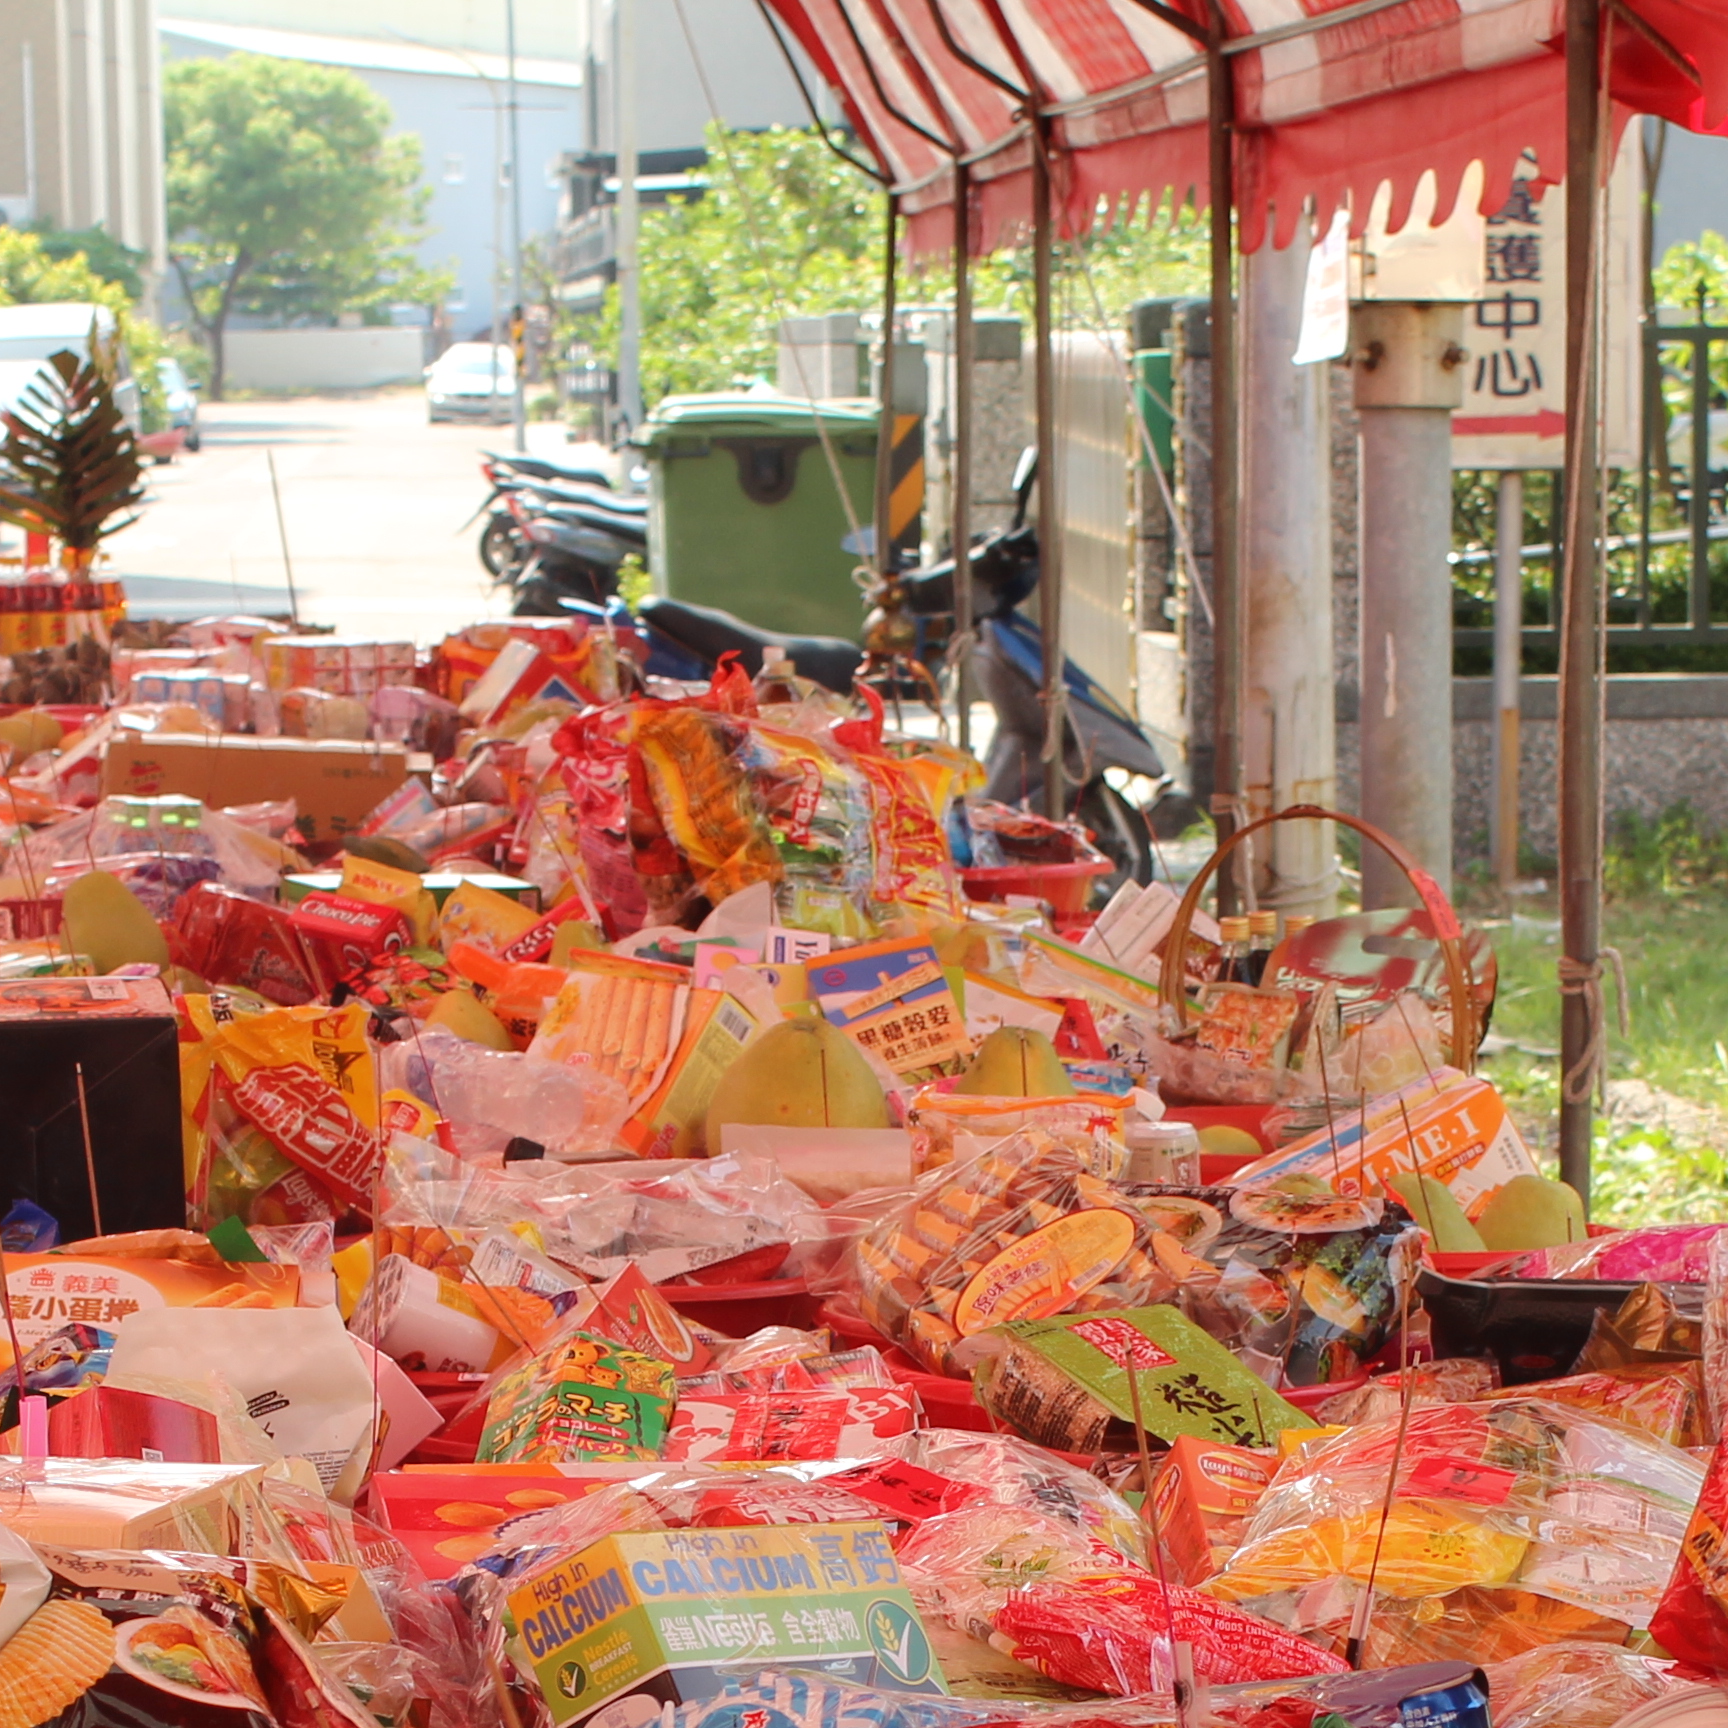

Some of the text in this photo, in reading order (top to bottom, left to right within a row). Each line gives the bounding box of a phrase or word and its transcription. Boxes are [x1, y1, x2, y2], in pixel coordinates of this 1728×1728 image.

[61, 1275, 120, 1296] 義美
[665, 1531, 759, 1557] High in
[631, 1530, 900, 1597] CALCIUM 高鈣
[533, 1561, 589, 1606] High in
[522, 1567, 630, 1659] CALCIUM
[780, 1607, 862, 1646] 含全穀物
[588, 1642, 633, 1673] BREAKFAST
[593, 1654, 638, 1686] Cereals
